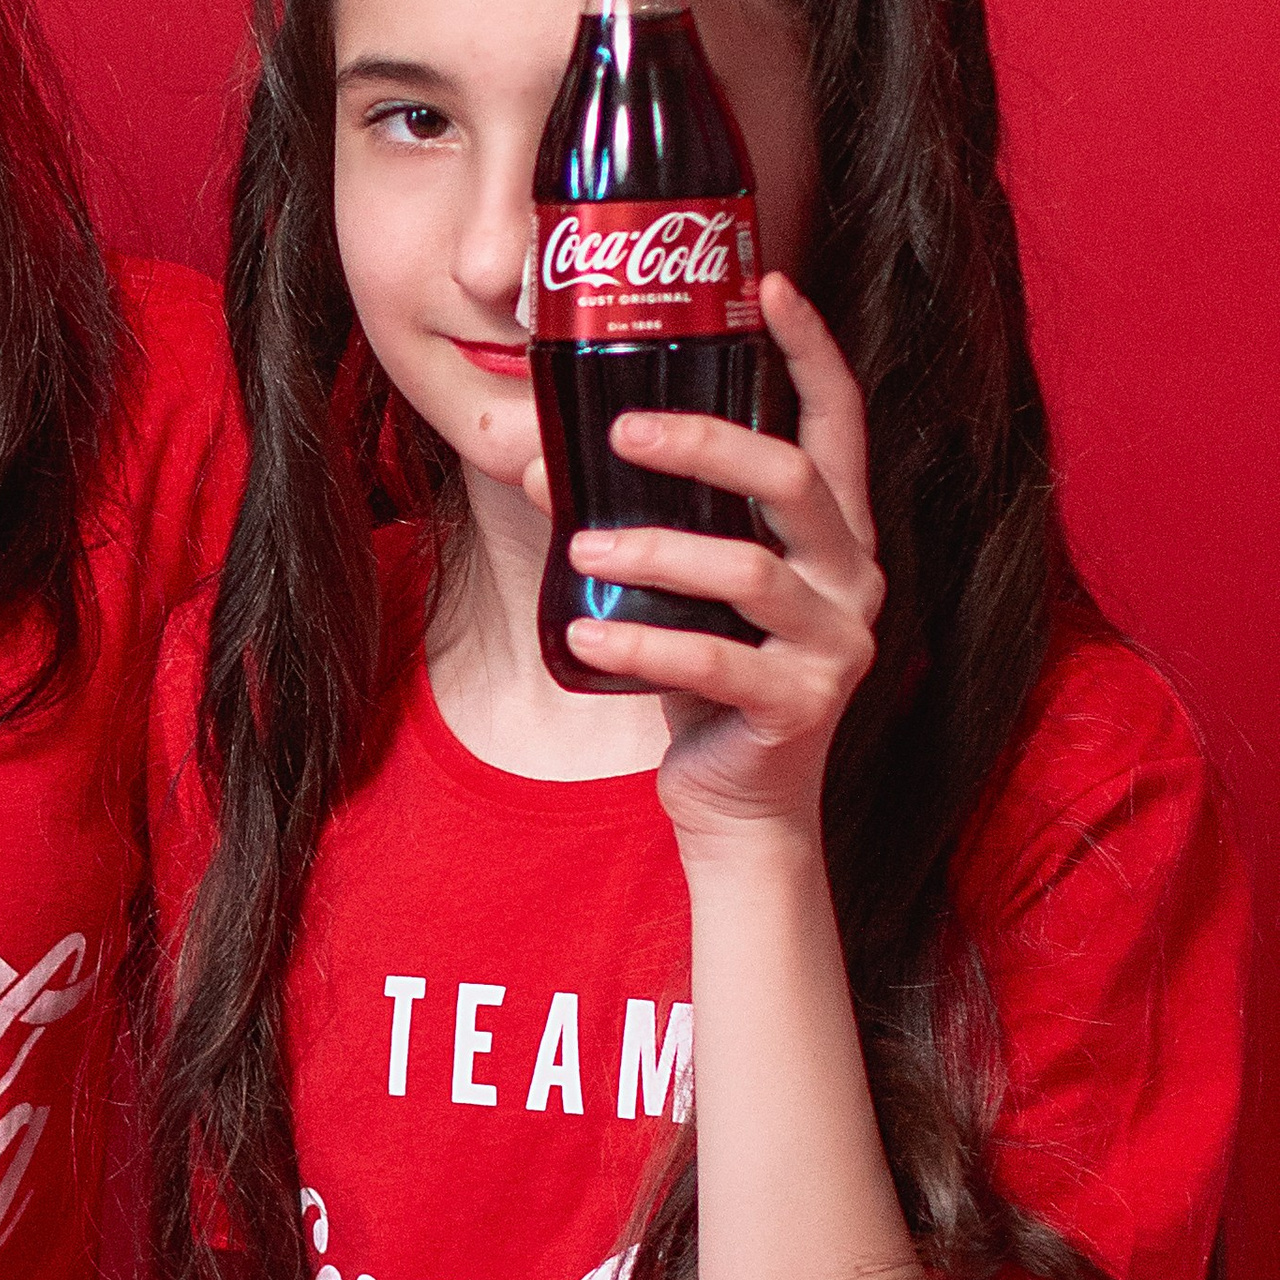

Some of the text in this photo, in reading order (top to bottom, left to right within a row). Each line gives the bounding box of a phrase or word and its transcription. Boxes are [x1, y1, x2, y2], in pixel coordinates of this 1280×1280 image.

[543, 211, 734, 291] Coca-Cola
[578, 292, 692, 307] GUST ORIGINAL
[384, 975, 693, 1123] TEAM
